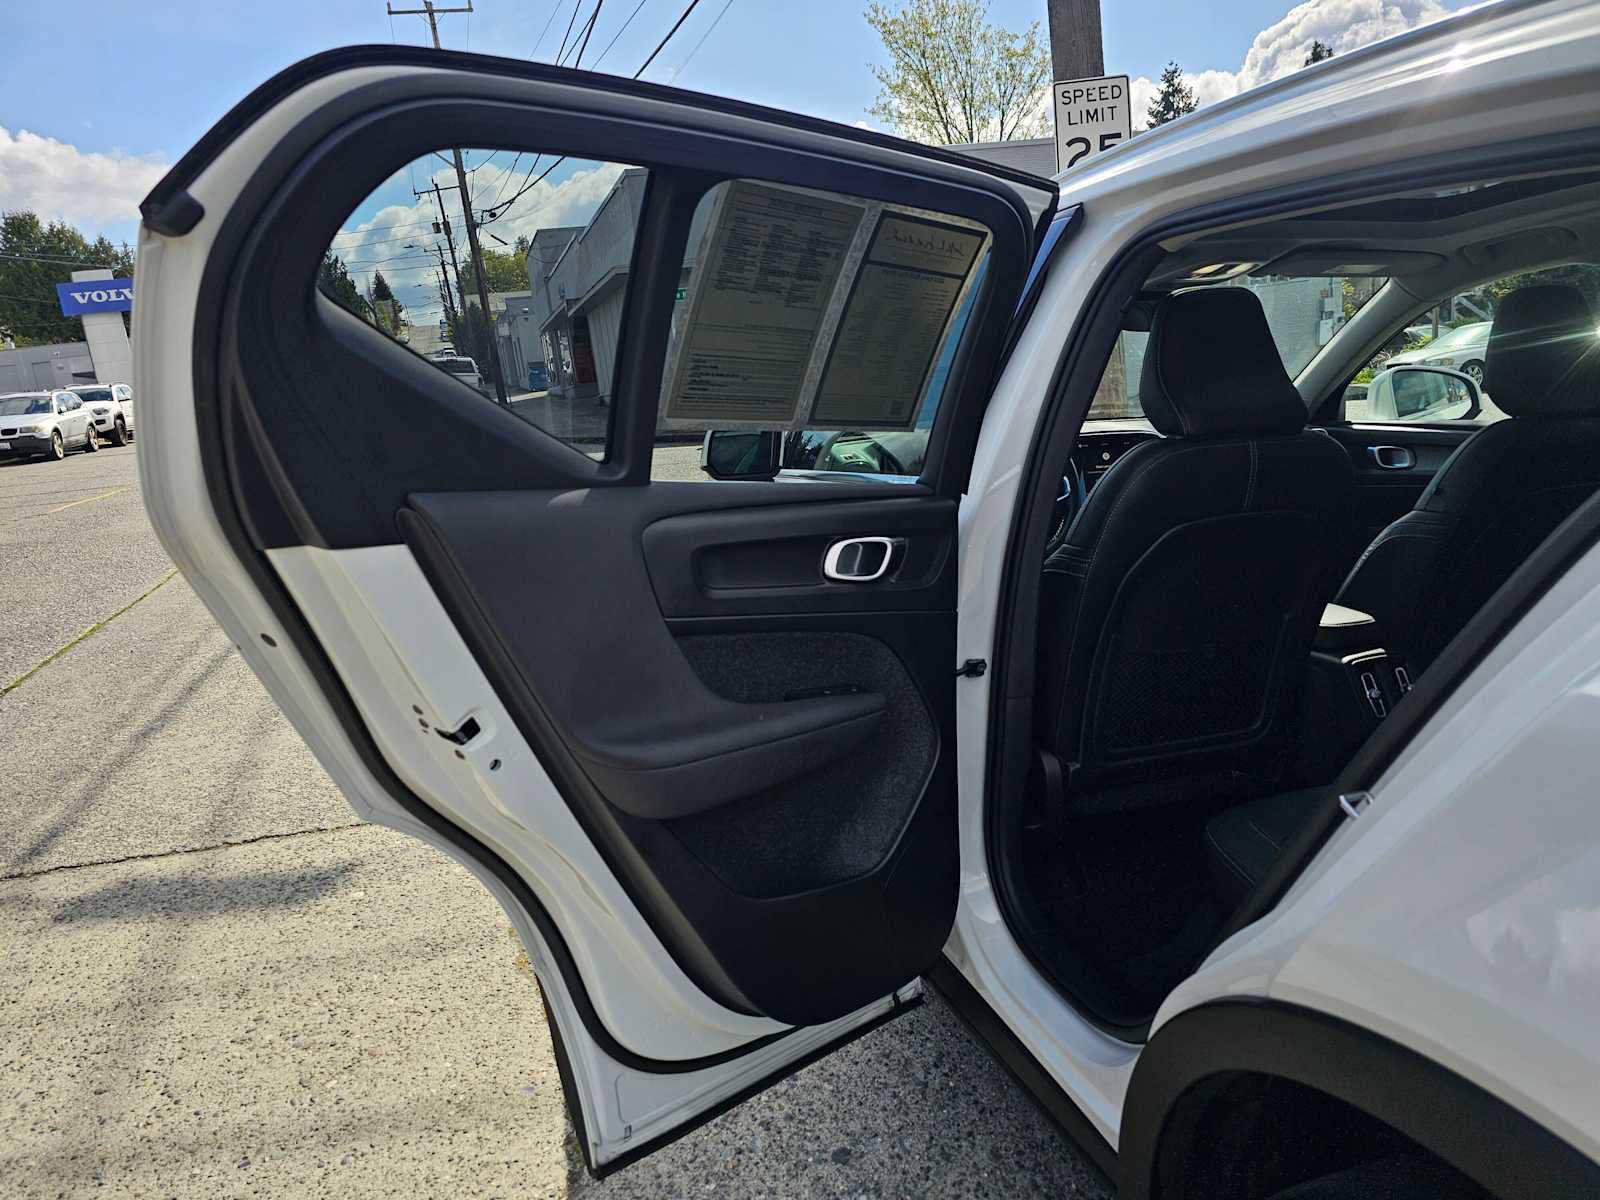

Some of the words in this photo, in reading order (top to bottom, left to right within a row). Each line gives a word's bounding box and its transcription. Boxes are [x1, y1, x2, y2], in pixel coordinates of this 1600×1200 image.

[1061, 85, 1122, 105] SPEED
[1067, 106, 1117, 126] LIMIT
[70, 288, 135, 304] VOLV
